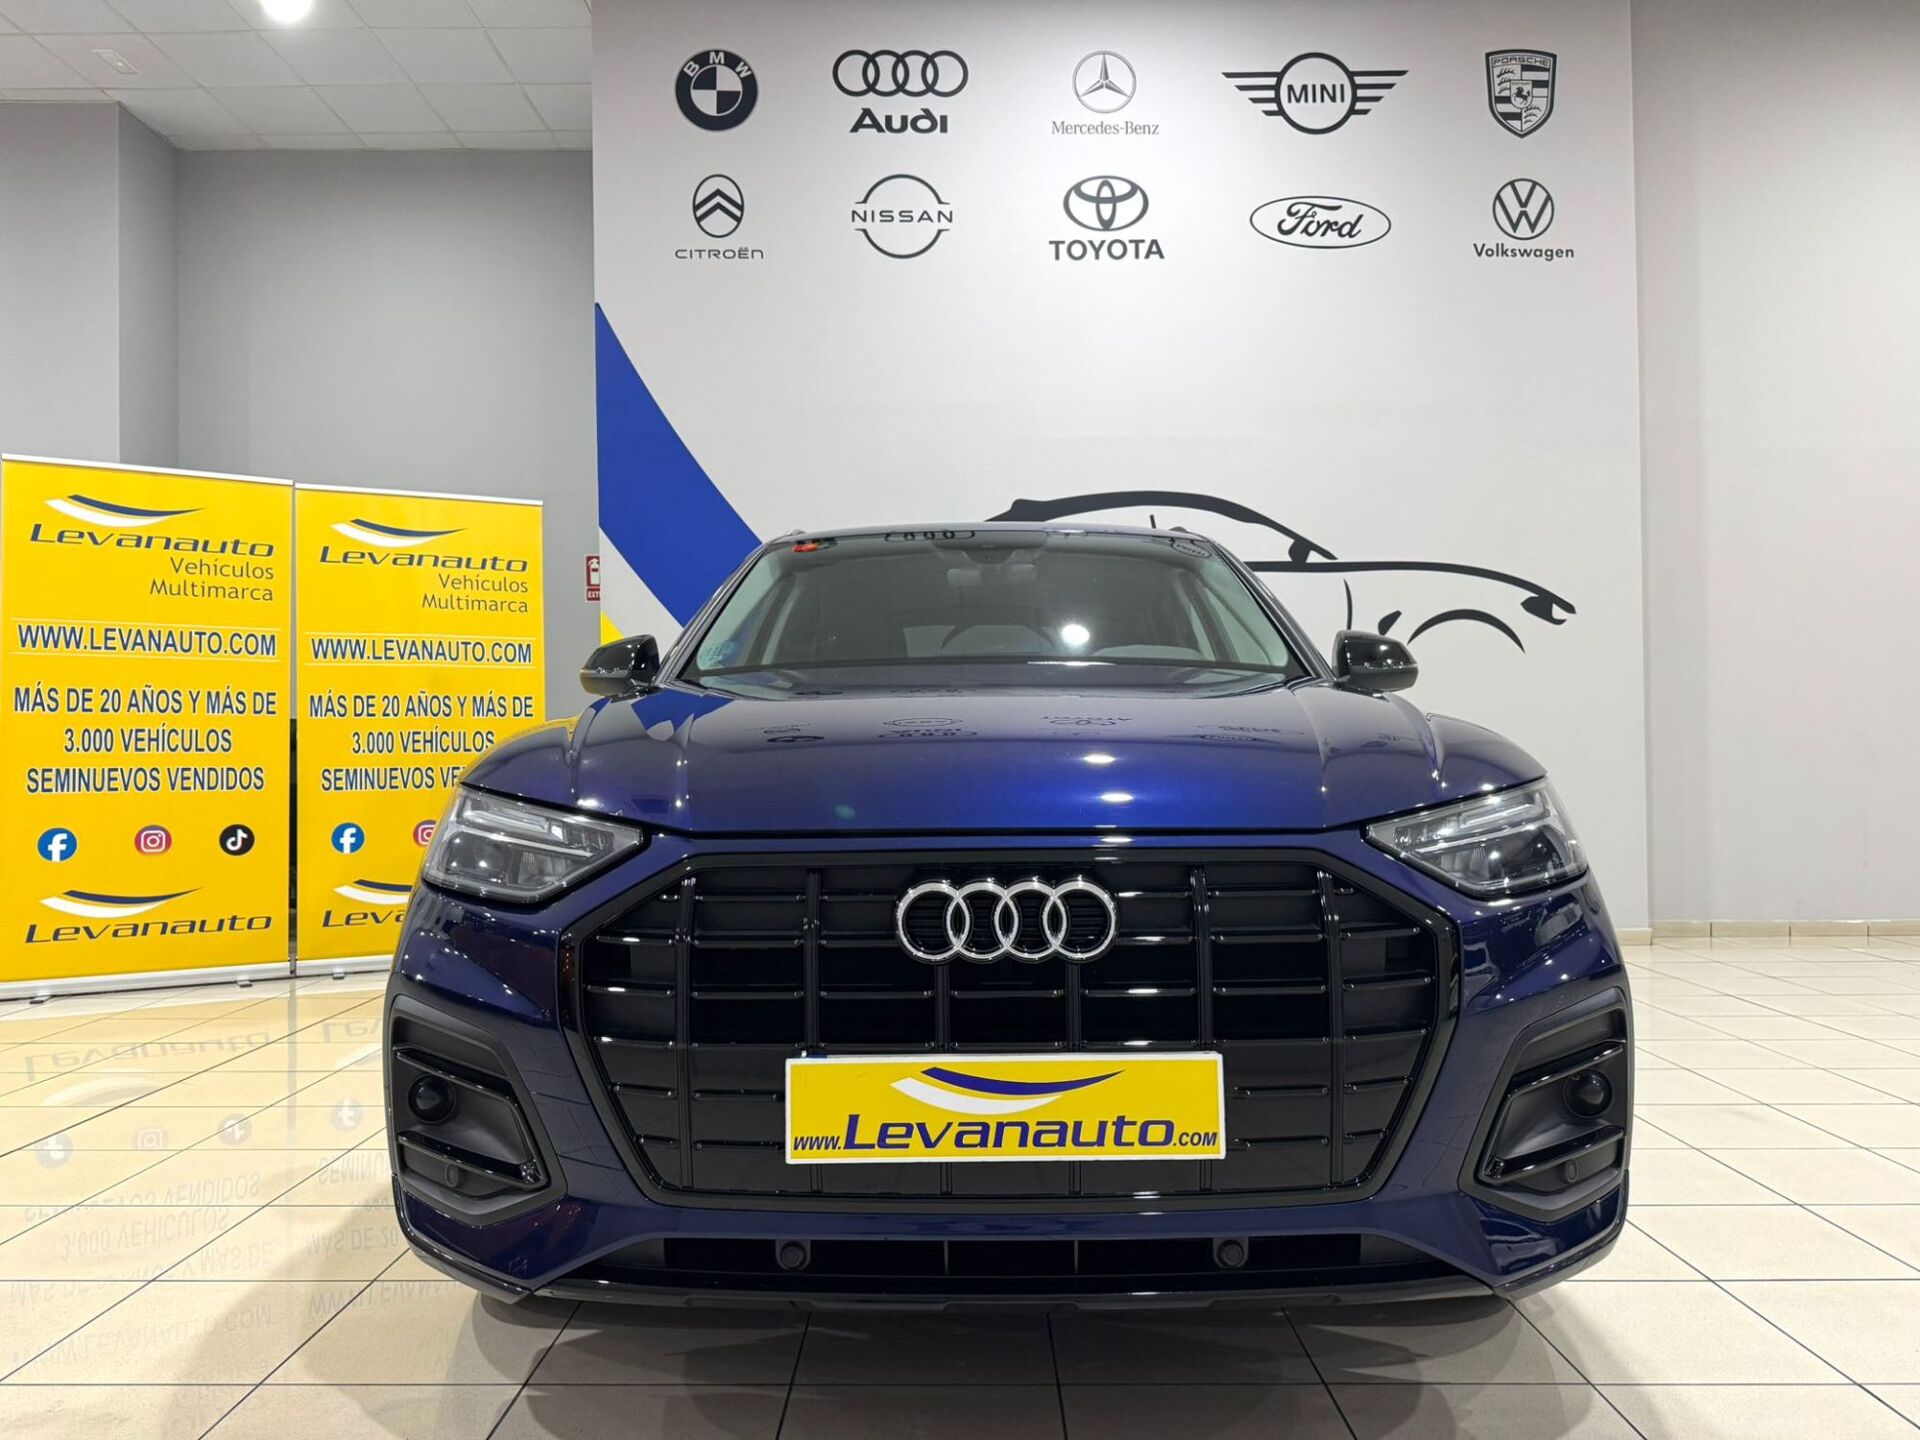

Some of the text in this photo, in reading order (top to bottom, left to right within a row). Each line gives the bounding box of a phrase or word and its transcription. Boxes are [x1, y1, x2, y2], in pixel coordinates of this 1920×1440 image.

[683, 51, 752, 78] BMW
[1493, 56, 1550, 66] PORSCHE
[1287, 83, 1345, 104] MINI
[849, 107, 949, 134] Audi
[1052, 120, 1160, 136] Mercedes-Benz
[851, 209, 954, 224] NISSAN
[1277, 201, 1365, 239] Ford
[1049, 238, 1165, 261] TOYOTA
[1473, 243, 1574, 261] Volkswagen
[30, 523, 274, 558] Levanauto
[170, 557, 274, 580] Vehículos
[319, 545, 528, 573] Levanauto
[149, 578, 274, 601] Multimarca
[438, 573, 528, 593] Vehículos
[421, 592, 528, 613] Multimarca
[17, 624, 276, 656] WWW.LEVANAUTO.COM
[311, 638, 532, 663] WWW.LEVANAUTO.COM
[14, 680, 277, 715] MÁS DE 20 AÑOS Y MÁS DE
[309, 689, 534, 718] MÁS DE 20 AÑOS Y MÁS DE
[64, 722, 232, 753] 3.000 VEHÍCULOS
[352, 724, 495, 754] 3.000 VEHÍCULOS
[26, 766, 264, 794] SEMINUEVOS VENDIDOS
[321, 766, 466, 792] SEMINUEVOS VE
[25, 914, 272, 943] Levanauto
